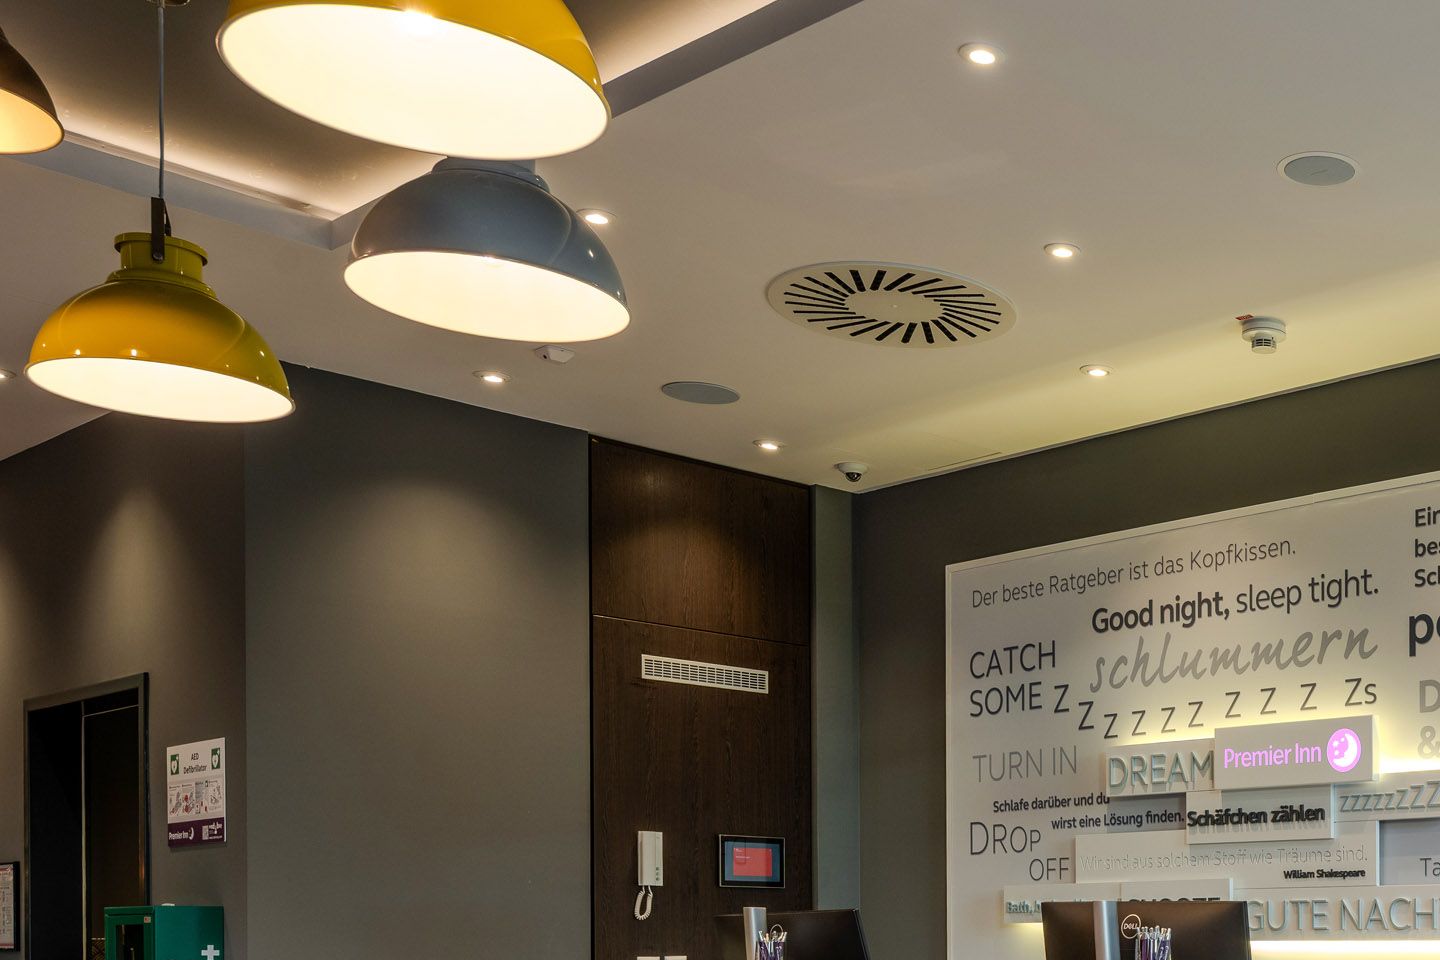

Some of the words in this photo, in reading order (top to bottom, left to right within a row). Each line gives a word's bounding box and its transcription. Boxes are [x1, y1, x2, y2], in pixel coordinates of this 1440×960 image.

[971, 587, 998, 608] Der
[1002, 581, 1044, 603] beste
[1049, 566, 1124, 598] Ratgeber
[1129, 560, 1149, 581] ist
[1154, 553, 1184, 578] das
[1190, 537, 1296, 571] Kopfkissen.
[1092, 601, 1154, 634] Good
[1160, 592, 1230, 628] night,
[1236, 582, 1301, 616] sleep
[1308, 569, 1380, 608] tight.
[970, 640, 1057, 680] CATCH
[1090, 626, 1378, 694] schlummern
[970, 681, 1043, 717] SOME
[1054, 684, 1070, 714] Z
[973, 749, 1042, 783] TURN
[1052, 745, 1077, 776] IN
[1109, 750, 1214, 789] DREAM
[1223, 746, 1291, 769] Premier
[1295, 742, 1322, 764] Inn
[993, 797, 1029, 813] Schlafe
[1031, 794, 1070, 811] darüber
[1073, 793, 1093, 807] und
[1096, 791, 1111, 805] du
[1187, 807, 1268, 828] Schäfchen
[1271, 804, 1327, 823] zählen
[1051, 815, 1077, 830] wirst
[1079, 815, 1101, 829] eine
[1103, 812, 1144, 831] Lösung
[1145, 809, 1185, 825] finden.
[970, 821, 1041, 856] DROP
[1029, 857, 1069, 881] OFF
[1283, 869, 1315, 880] William
[1316, 867, 1366, 880] Shakespeare
[1248, 898, 1329, 931] GUTE
